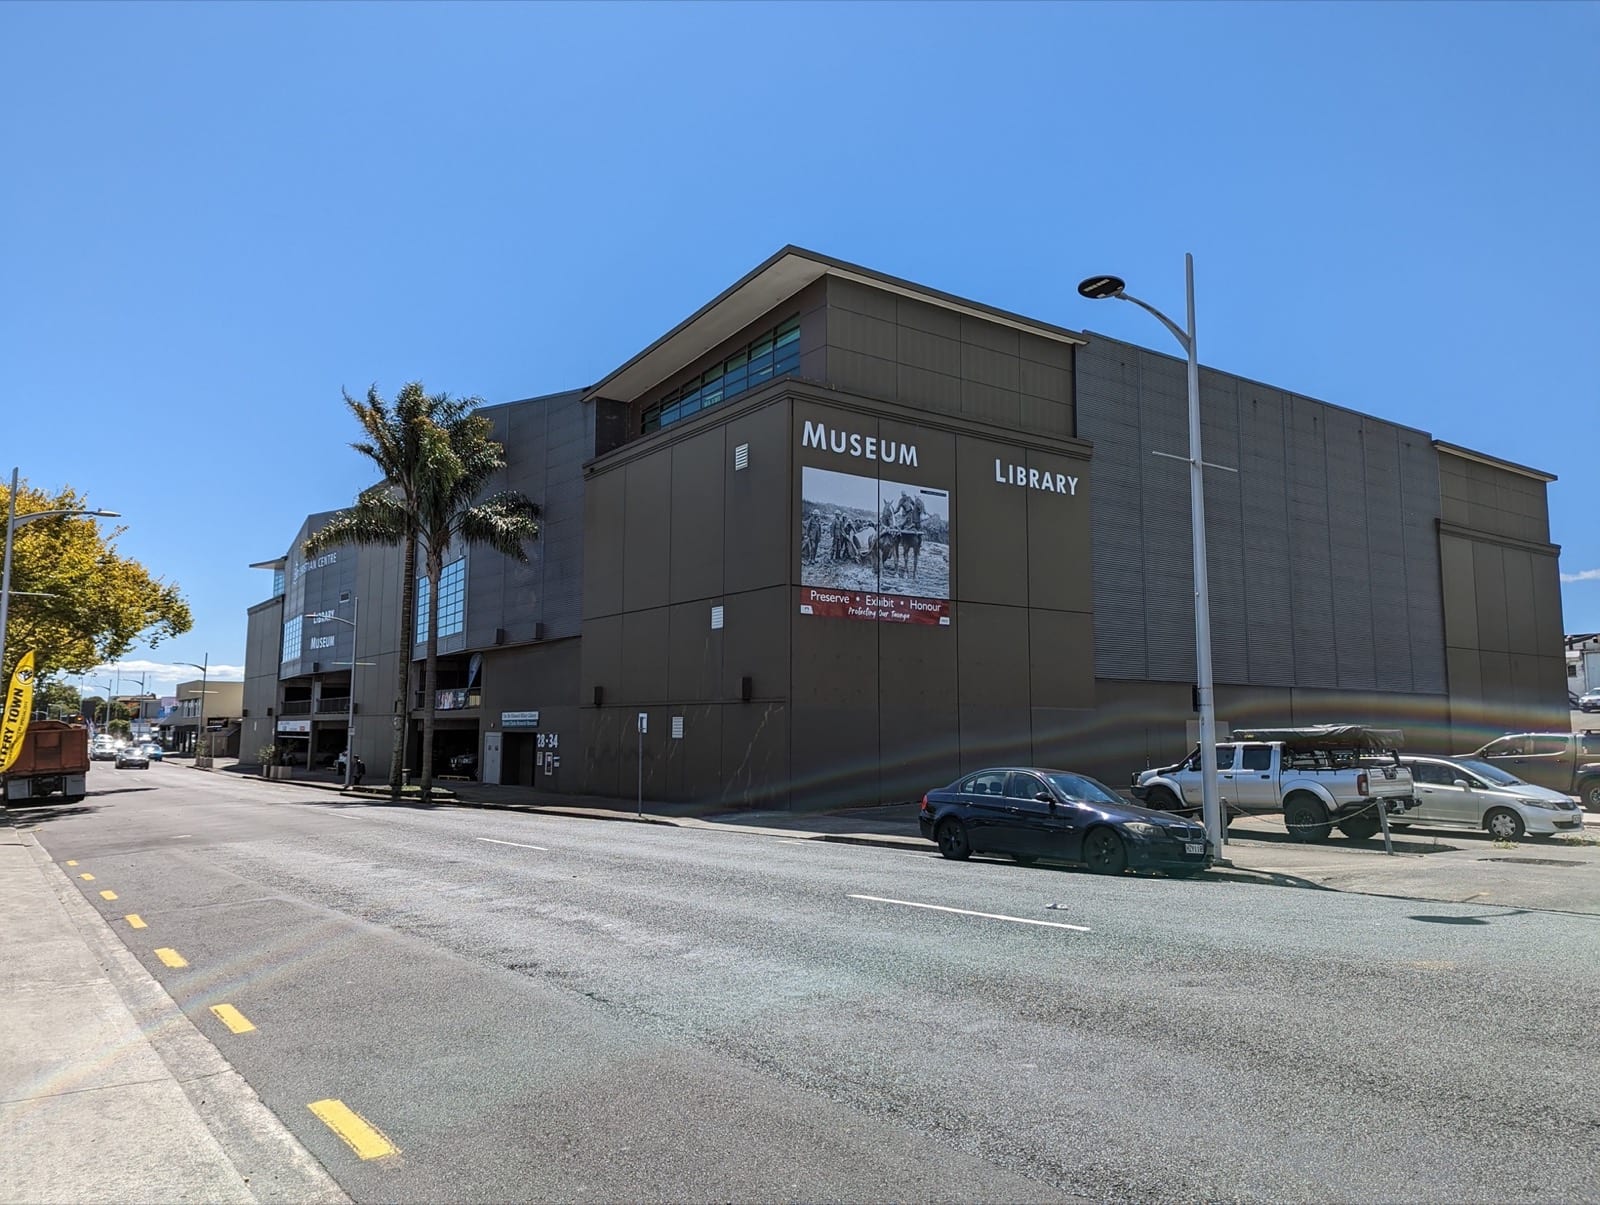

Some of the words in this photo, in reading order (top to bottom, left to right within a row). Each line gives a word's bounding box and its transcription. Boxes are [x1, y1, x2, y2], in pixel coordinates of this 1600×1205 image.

[802, 421, 918, 467] MUSEUM
[994, 458, 1078, 496] LIBRARY
[317, 552, 337, 568] CENTRE
[810, 589, 850, 604] Preserve
[865, 594, 895, 608] Exhibit
[909, 600, 942, 612] Honour
[310, 635, 335, 650] MUSEUM
[7, 687, 24, 724] TOWN
